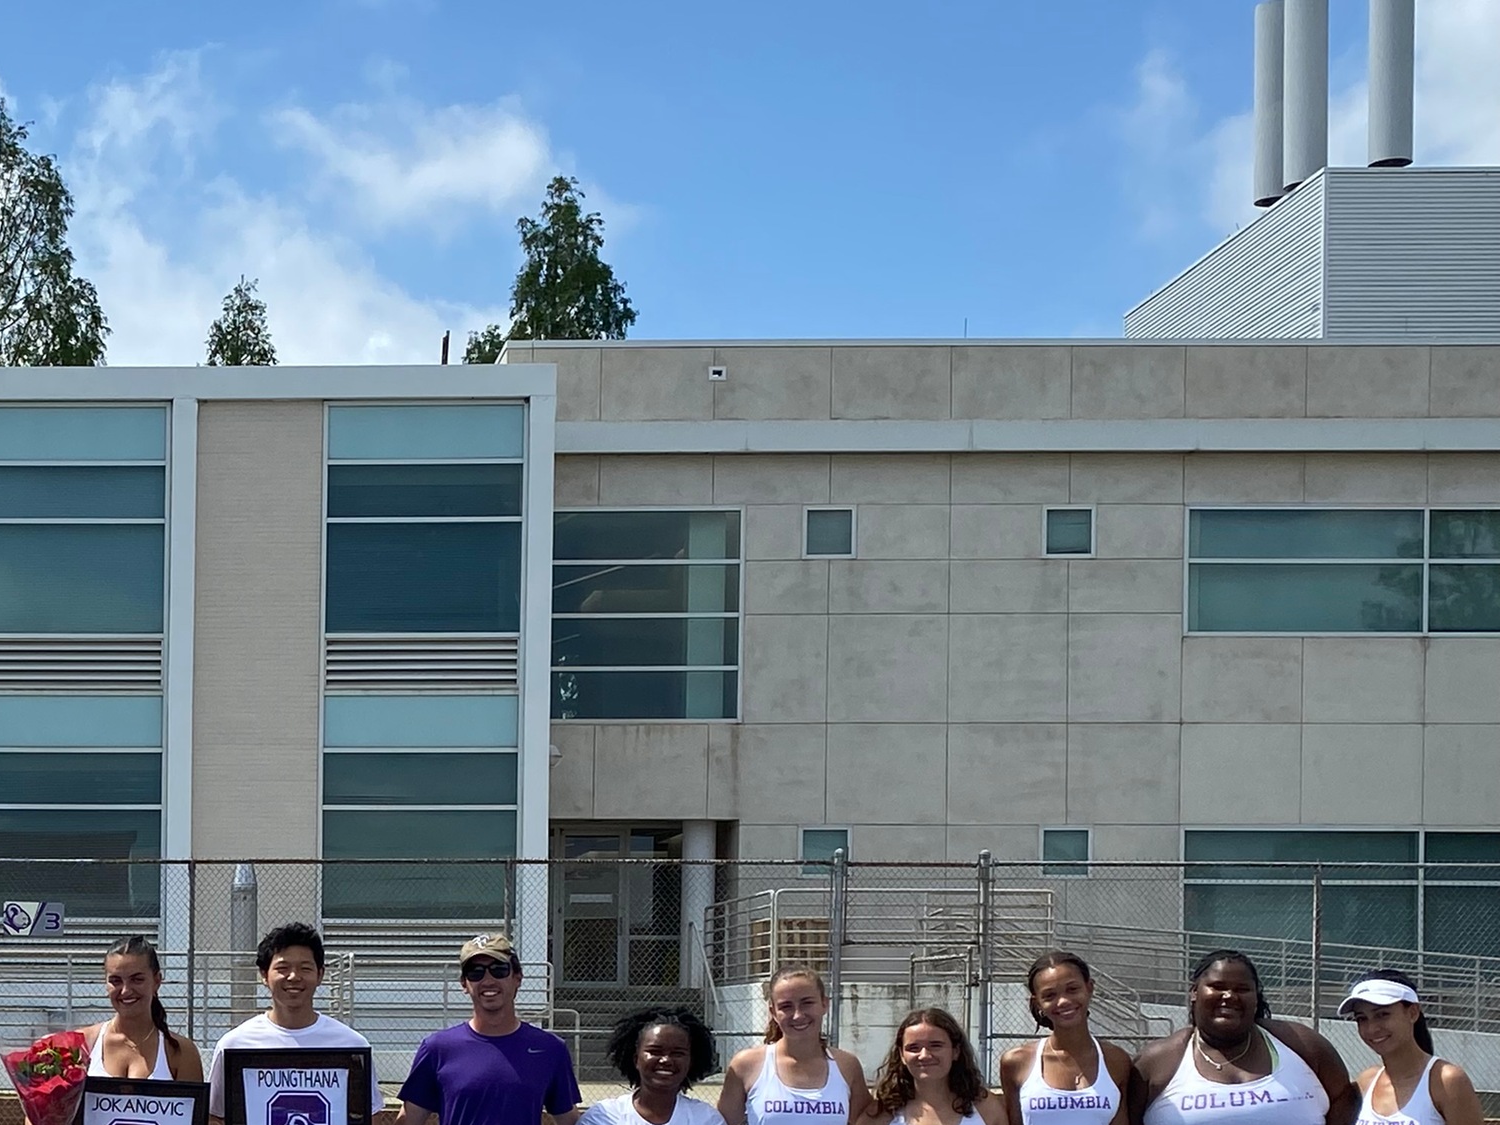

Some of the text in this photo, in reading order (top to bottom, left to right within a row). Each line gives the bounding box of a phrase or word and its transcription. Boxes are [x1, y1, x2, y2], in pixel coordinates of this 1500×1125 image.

[45, 913, 61, 930] 3
[258, 1069, 340, 1089] POUNGTHANA
[91, 1098, 184, 1117] JOKANOVIC
[764, 1099, 846, 1115] COLUMBIA
[1029, 1096, 1111, 1111] COLUMBIA
[1180, 1090, 1314, 1111] COLUM
